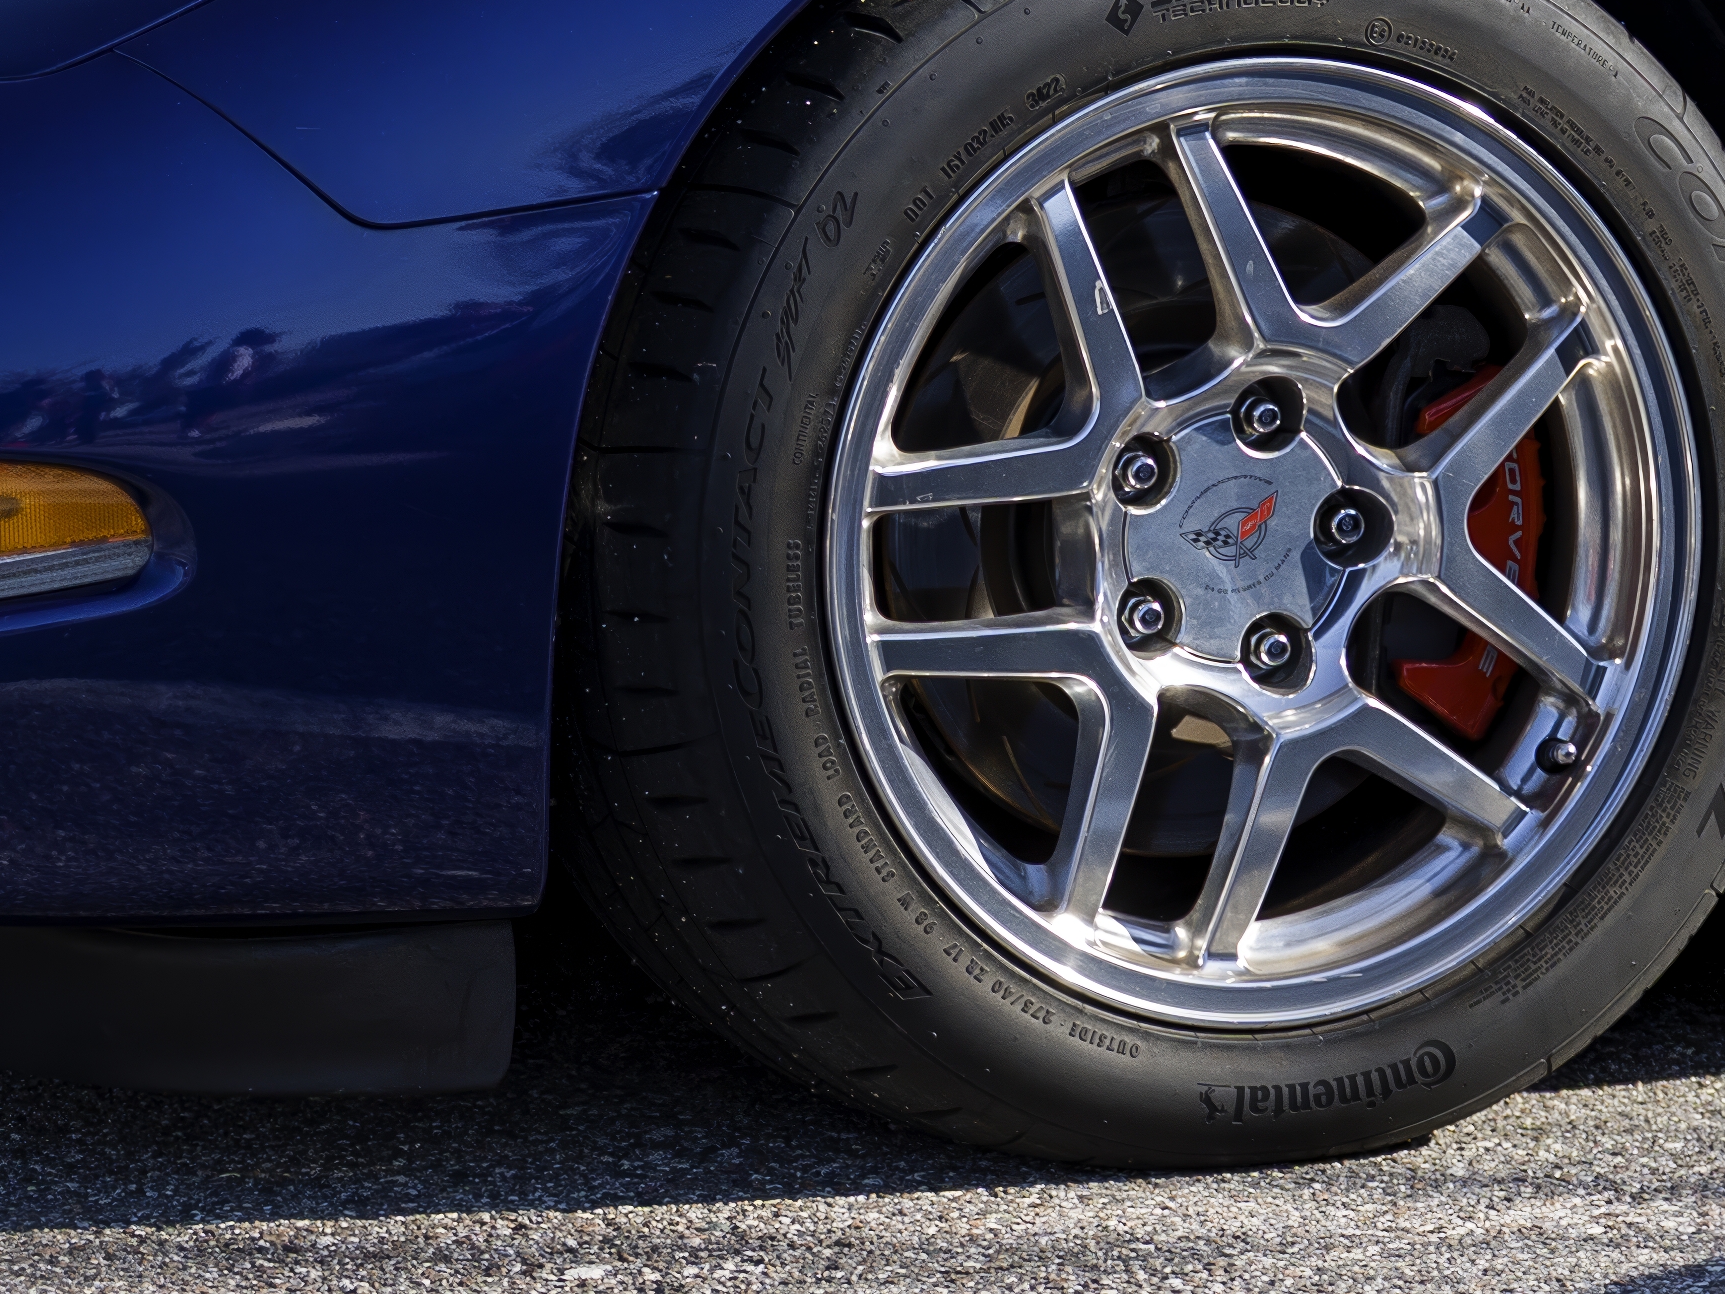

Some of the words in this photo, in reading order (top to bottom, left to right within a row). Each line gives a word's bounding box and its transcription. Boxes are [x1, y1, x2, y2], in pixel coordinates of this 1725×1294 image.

[903, 186, 935, 223] DOT
[786, 539, 805, 631] TUBELESS
[793, 645, 821, 719] RADIAL
[813, 732, 842, 781] LOAD
[836, 792, 897, 884] STANDARD
[896, 890, 917, 912] W
[913, 910, 938, 936] 98
[943, 939, 966, 964] 17
[964, 958, 990, 985] ZR
[990, 978, 1055, 1026] 275/40
[1068, 1020, 1142, 1059] OUTSIDE
[1233, 1039, 1458, 1126] Continental
